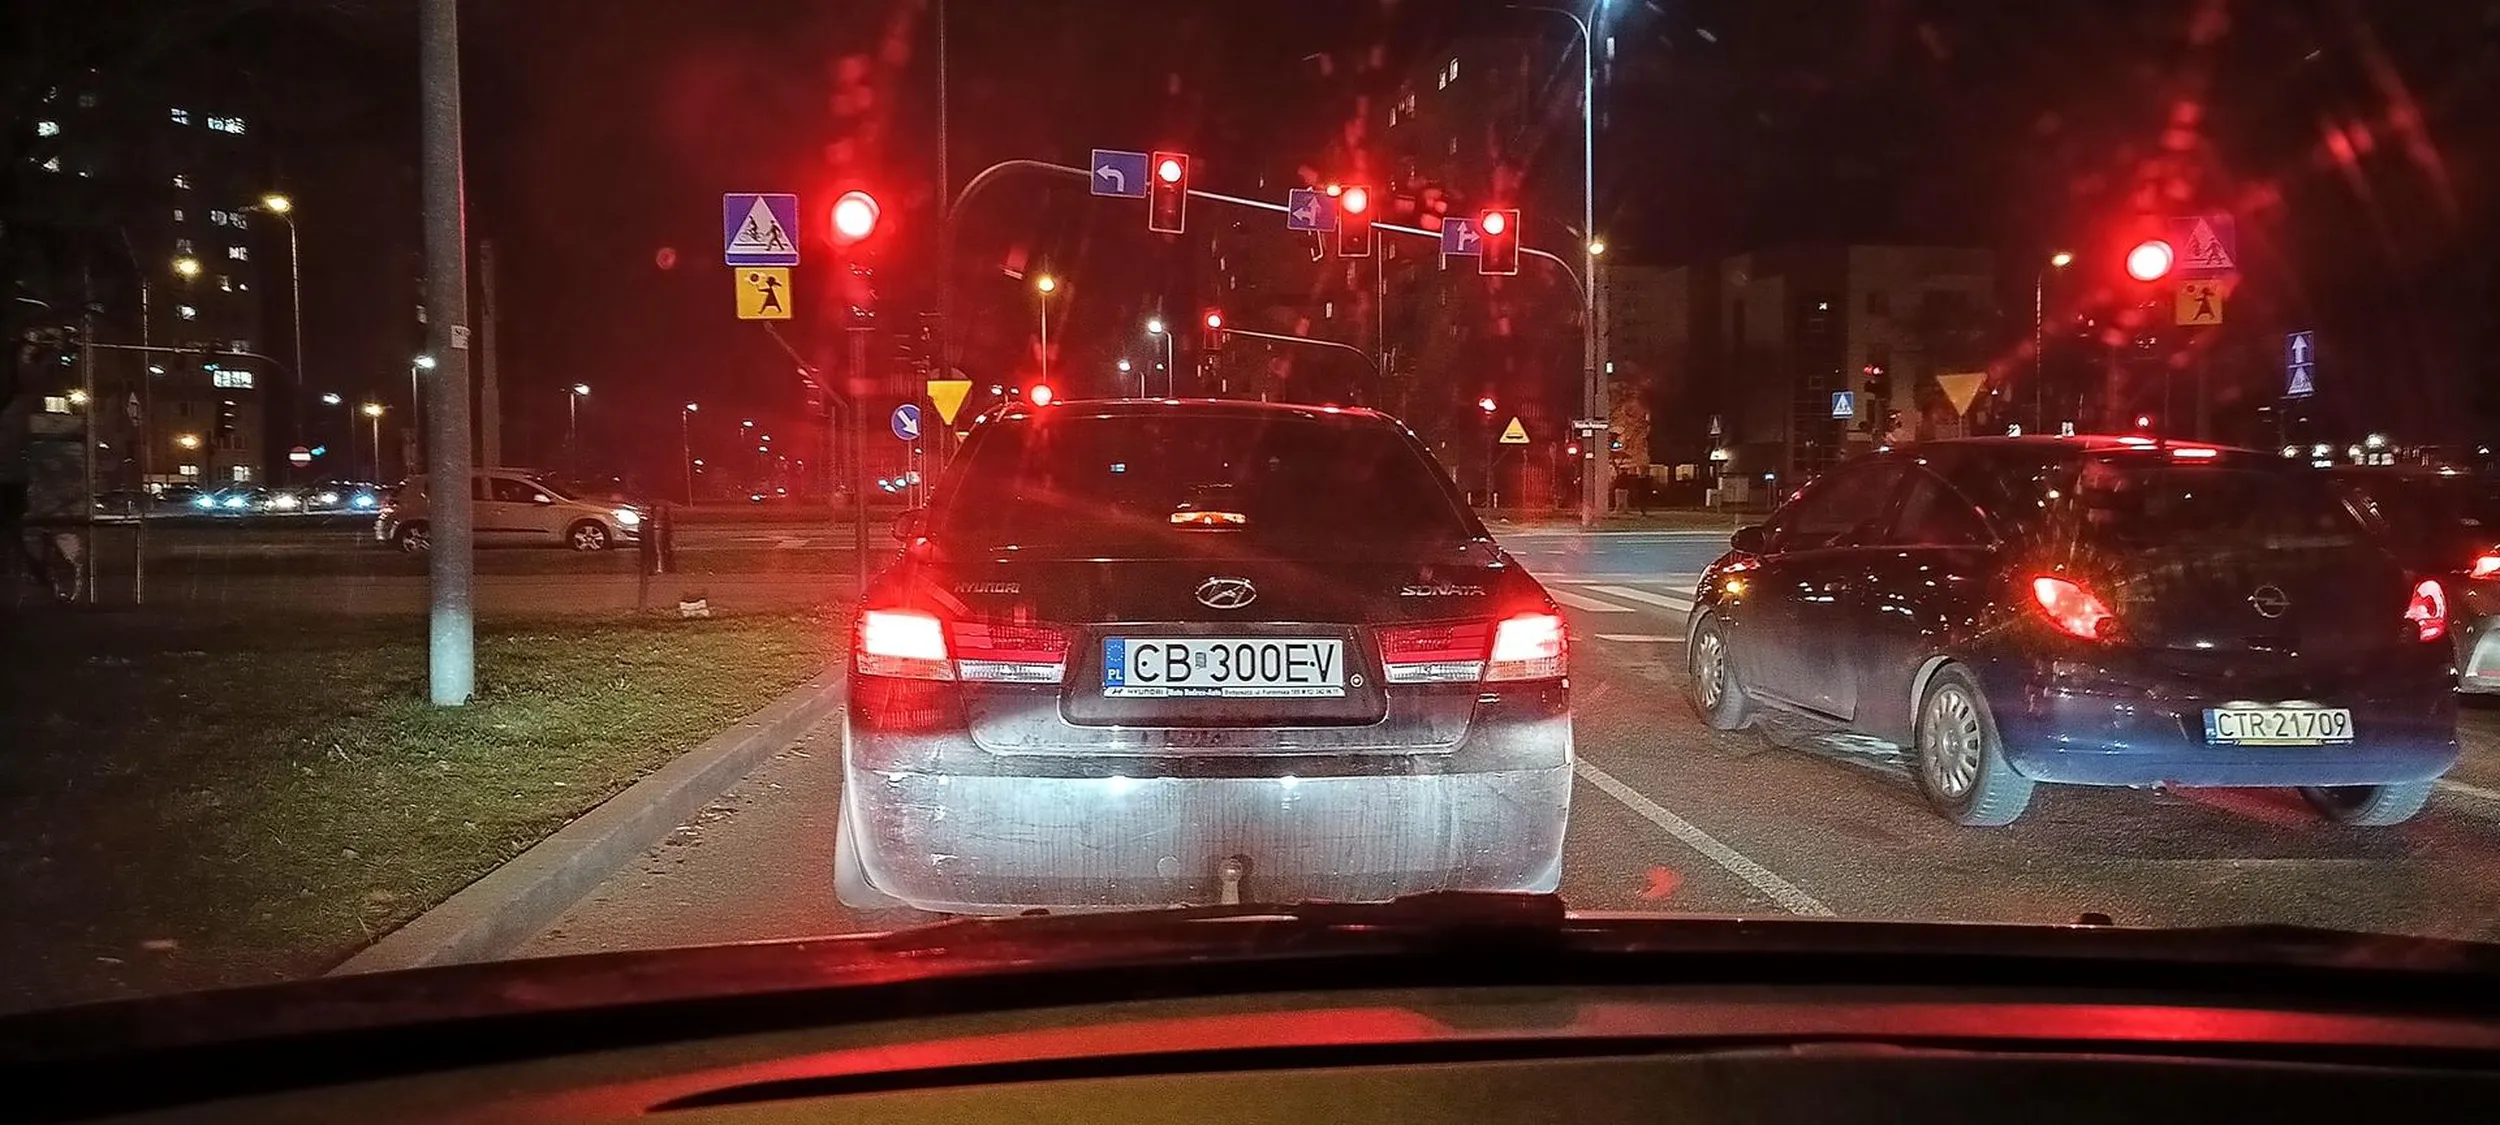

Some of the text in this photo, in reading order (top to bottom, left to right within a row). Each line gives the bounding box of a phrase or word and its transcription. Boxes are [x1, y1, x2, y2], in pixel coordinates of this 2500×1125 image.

[1400, 584, 1486, 597] SONATA
[1134, 644, 1334, 682] CB 300EV
[1107, 668, 1123, 680] PL
[2218, 712, 2346, 737] CTR 21709
